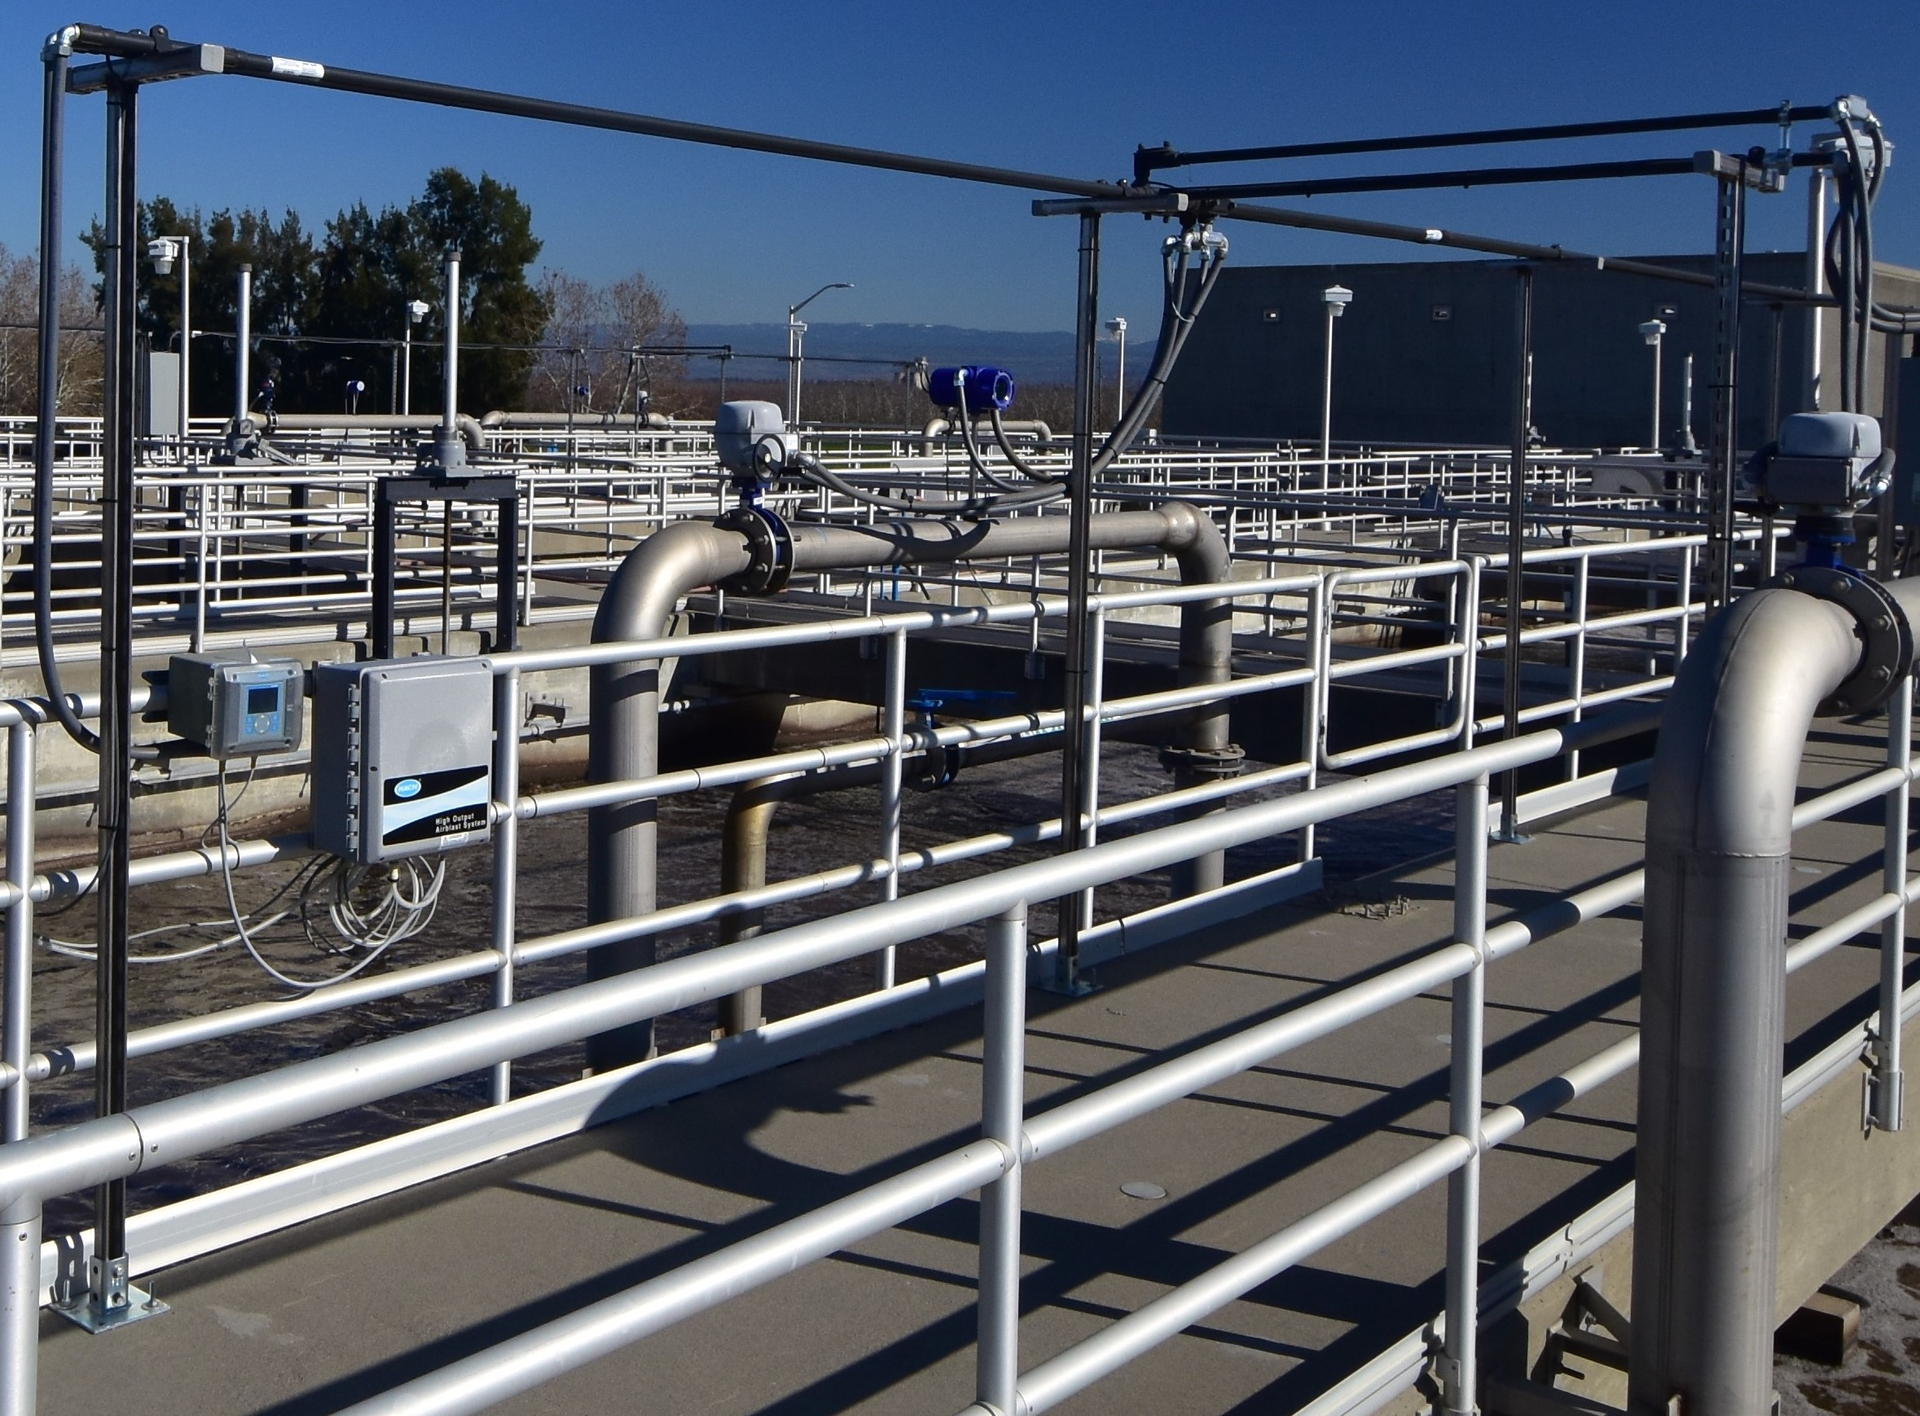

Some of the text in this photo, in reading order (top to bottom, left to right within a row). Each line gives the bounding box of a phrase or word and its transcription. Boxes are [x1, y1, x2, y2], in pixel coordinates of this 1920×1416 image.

[435, 812, 475, 826] High Output
[435, 819, 486, 833] Airblast System
